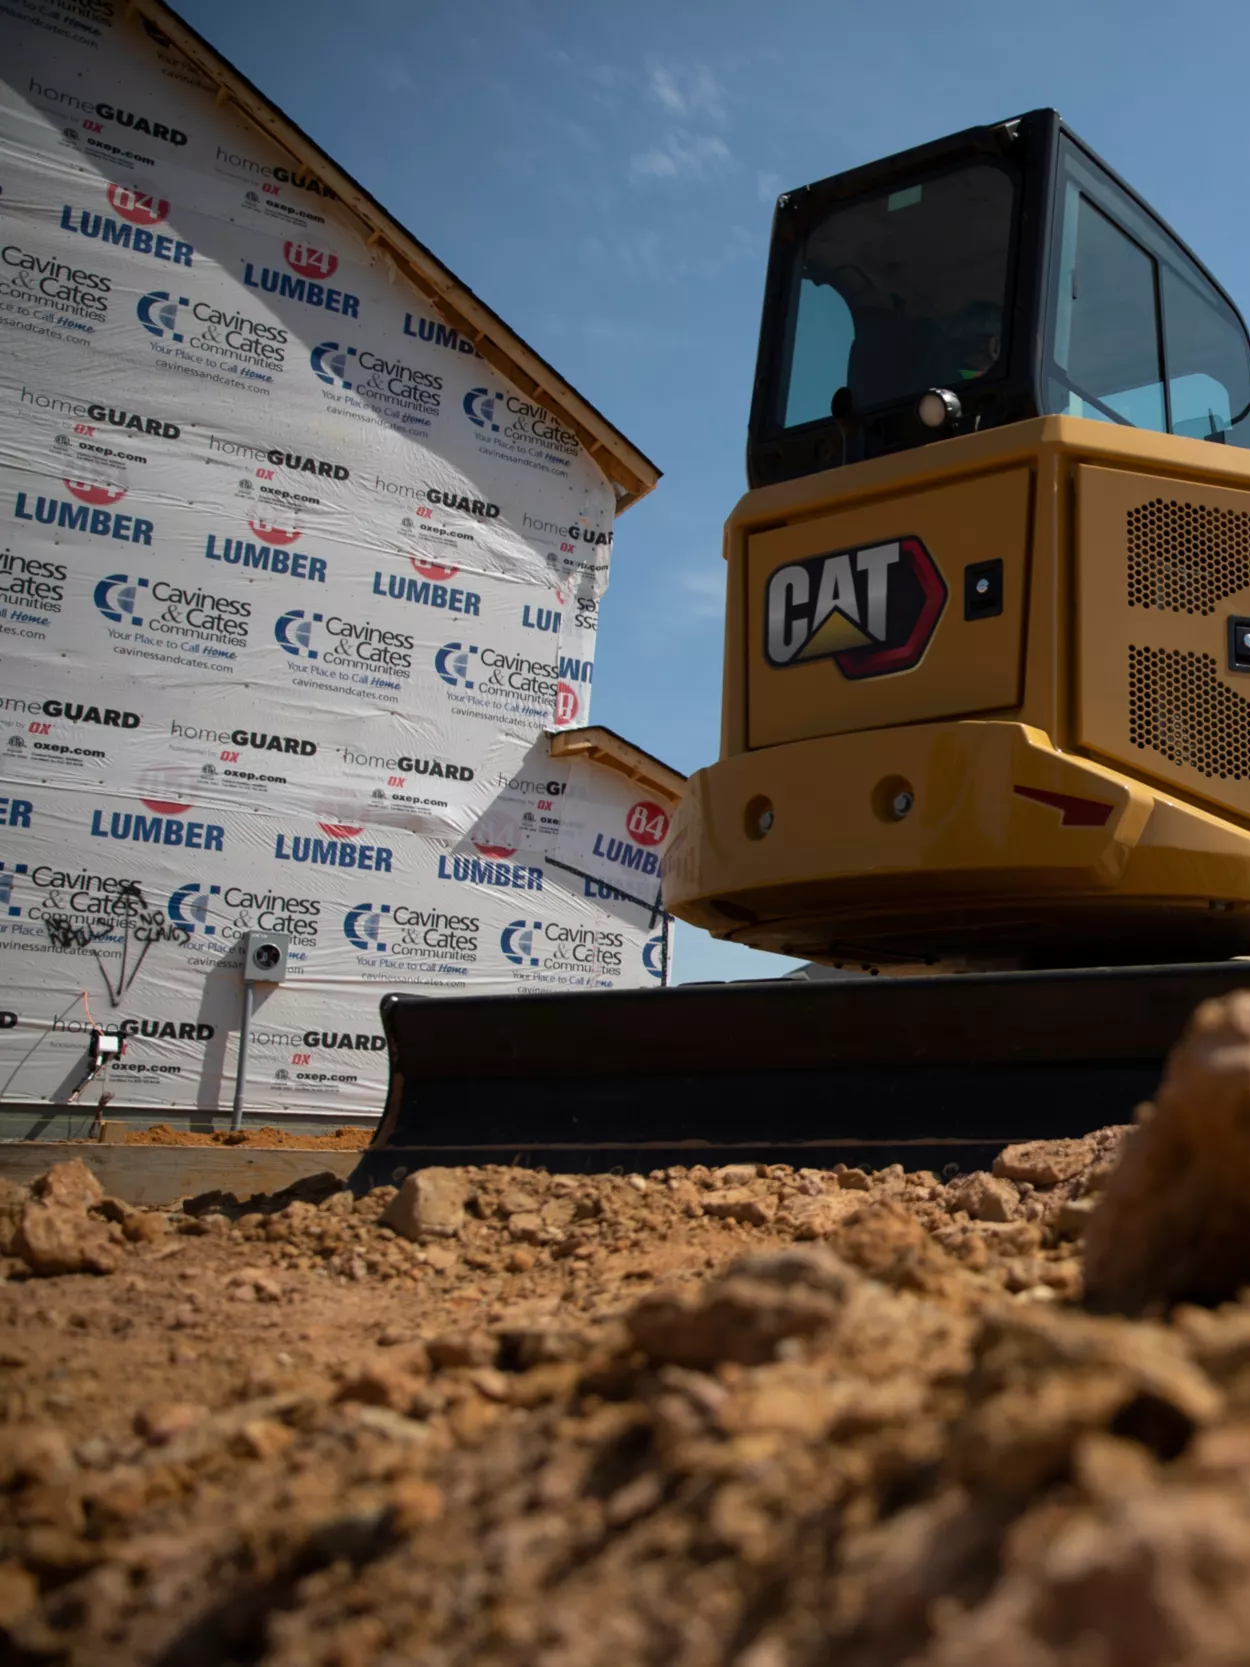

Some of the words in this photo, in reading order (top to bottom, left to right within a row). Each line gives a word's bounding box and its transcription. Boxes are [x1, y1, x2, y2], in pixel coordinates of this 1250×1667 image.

[29, 77, 188, 146] homeGUARD
[87, 136, 156, 166] oxep.com
[266, 200, 325, 224] oxep.com
[60, 204, 195, 267] LUMBER
[2, 246, 112, 292] Caviness
[12, 270, 36, 290] &
[40, 277, 108, 311] Cates
[243, 263, 360, 319] LUMBER
[18, 305, 30, 316] to
[33, 310, 54, 323] Call
[193, 303, 288, 344] Caviness
[150, 341, 172, 355] Your
[175, 348, 203, 364] Place
[206, 357, 216, 367] to
[220, 362, 237, 373] Call
[190, 337, 284, 372] Communities
[202, 324, 222, 343] &
[226, 331, 285, 361] Cates
[155, 359, 270, 396] cavinessandcates.com
[359, 352, 443, 390] Caviness
[321, 389, 342, 401] Your
[371, 404, 381, 413] to
[384, 407, 399, 419] Call
[356, 384, 439, 416] Communities
[367, 372, 384, 390] &
[388, 378, 441, 406] Cates
[21, 386, 180, 439] homeGUARD
[504, 427, 578, 456] Communities
[513, 415, 529, 432] &
[532, 420, 579, 446] Cates
[79, 441, 147, 465] oxep.com
[209, 435, 349, 481] homeGUARD
[517, 445, 526, 453] to
[528, 448, 543, 457] Call
[260, 486, 320, 505] oxep.com
[375, 475, 500, 519] homeGUARD
[15, 492, 154, 546] LUMBER
[420, 523, 474, 542] oxep.com
[205, 534, 328, 583] LUMBER
[152, 582, 251, 617] Caviness
[372, 571, 481, 616] LUMBER
[768, 541, 900, 664] CAT
[149, 619, 247, 647] Communities
[161, 605, 186, 624] &
[187, 609, 249, 636] Cates
[326, 617, 414, 650] Caviness
[108, 628, 132, 641] Your
[134, 632, 163, 647] Place
[167, 640, 178, 649] to
[181, 642, 200, 653] Call
[334, 638, 353, 657] &
[356, 642, 411, 668] Cates
[113, 645, 233, 673] cavinessandcates.com
[287, 660, 308, 673] Your
[310, 665, 336, 678] Place
[339, 672, 349, 680] to
[352, 674, 368, 684] Call
[323, 652, 410, 679] Communities
[481, 649, 559, 679] Caviness
[292, 678, 398, 703] cavinessandcates.com
[479, 682, 556, 706] Communities
[489, 668, 505, 686] &
[508, 672, 557, 696] Cates
[446, 691, 465, 702] Your
[493, 701, 502, 709] to
[504, 702, 519, 712] Call
[34, 740, 105, 758] oxep.com
[171, 720, 317, 756] homeGUARD
[224, 768, 287, 784] oxep.com
[344, 748, 474, 782] homeGUARD
[392, 793, 448, 808] oxep.com
[91, 810, 225, 851] LUMBER
[628, 805, 663, 841] 84
[275, 834, 393, 872] LUMBER
[437, 855, 543, 892] LUMBER
[43, 890, 65, 910] &
[70, 891, 138, 918] Cates
[225, 887, 321, 915] Caviness
[234, 909, 252, 929] &
[258, 912, 318, 935] Cates
[394, 907, 480, 932] Caviness
[392, 943, 477, 962] Communities
[402, 928, 422, 945] &
[424, 929, 478, 951] Cates
[553, 943, 571, 960] &
[356, 956, 377, 967] Your
[380, 958, 404, 970] Place
[408, 962, 417, 970] to
[420, 963, 436, 972] Call
[569, 977, 584, 985] Call
[112, 1062, 181, 1073] oxep.com
[296, 1072, 357, 1082] oxep.com
